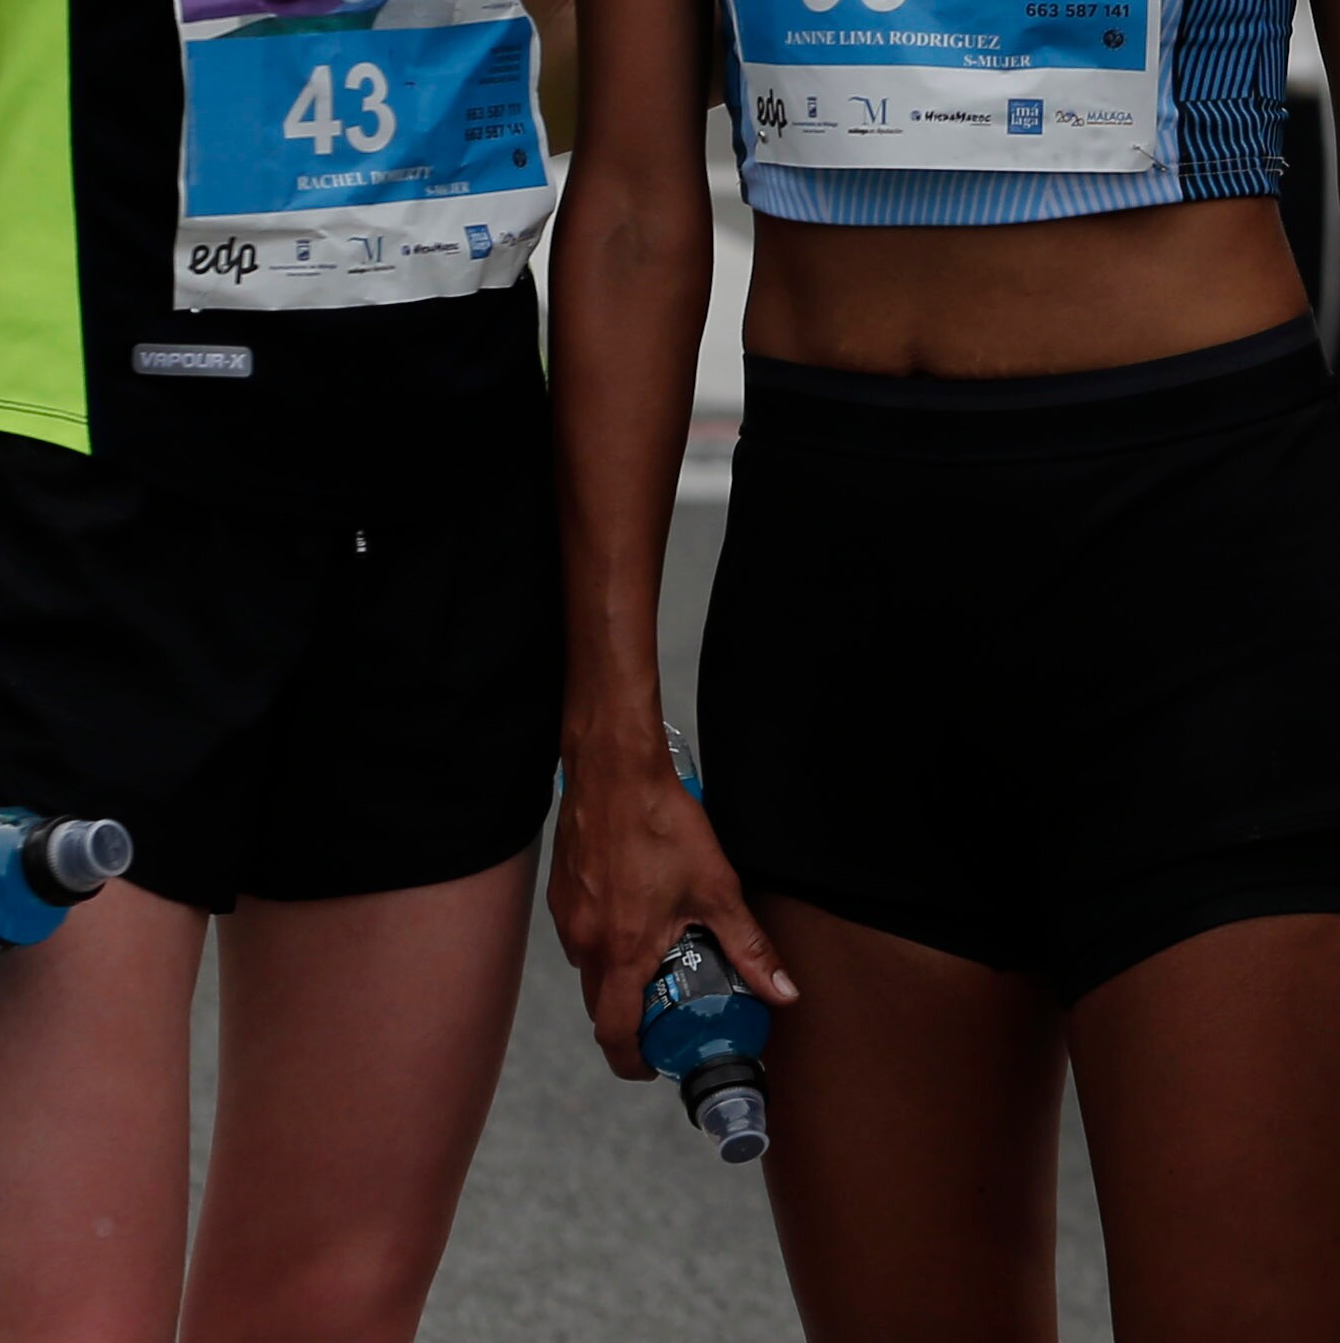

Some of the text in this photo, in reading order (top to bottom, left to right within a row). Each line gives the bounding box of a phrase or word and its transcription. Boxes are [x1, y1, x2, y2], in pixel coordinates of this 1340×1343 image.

[1026, 3, 1129, 17] 663 587 141
[784, 30, 1001, 50] JANINE LIMA RODRIGUEZ
[963, 54, 1031, 67] S-MUJER
[284, 62, 397, 155] 43
[757, 89, 787, 138] edp
[1087, 111, 1133, 122] MÁLAGA
[296, 172, 367, 191] RACHEL
[189, 236, 258, 284] edp
[139, 351, 248, 369] VAPOUR-X
